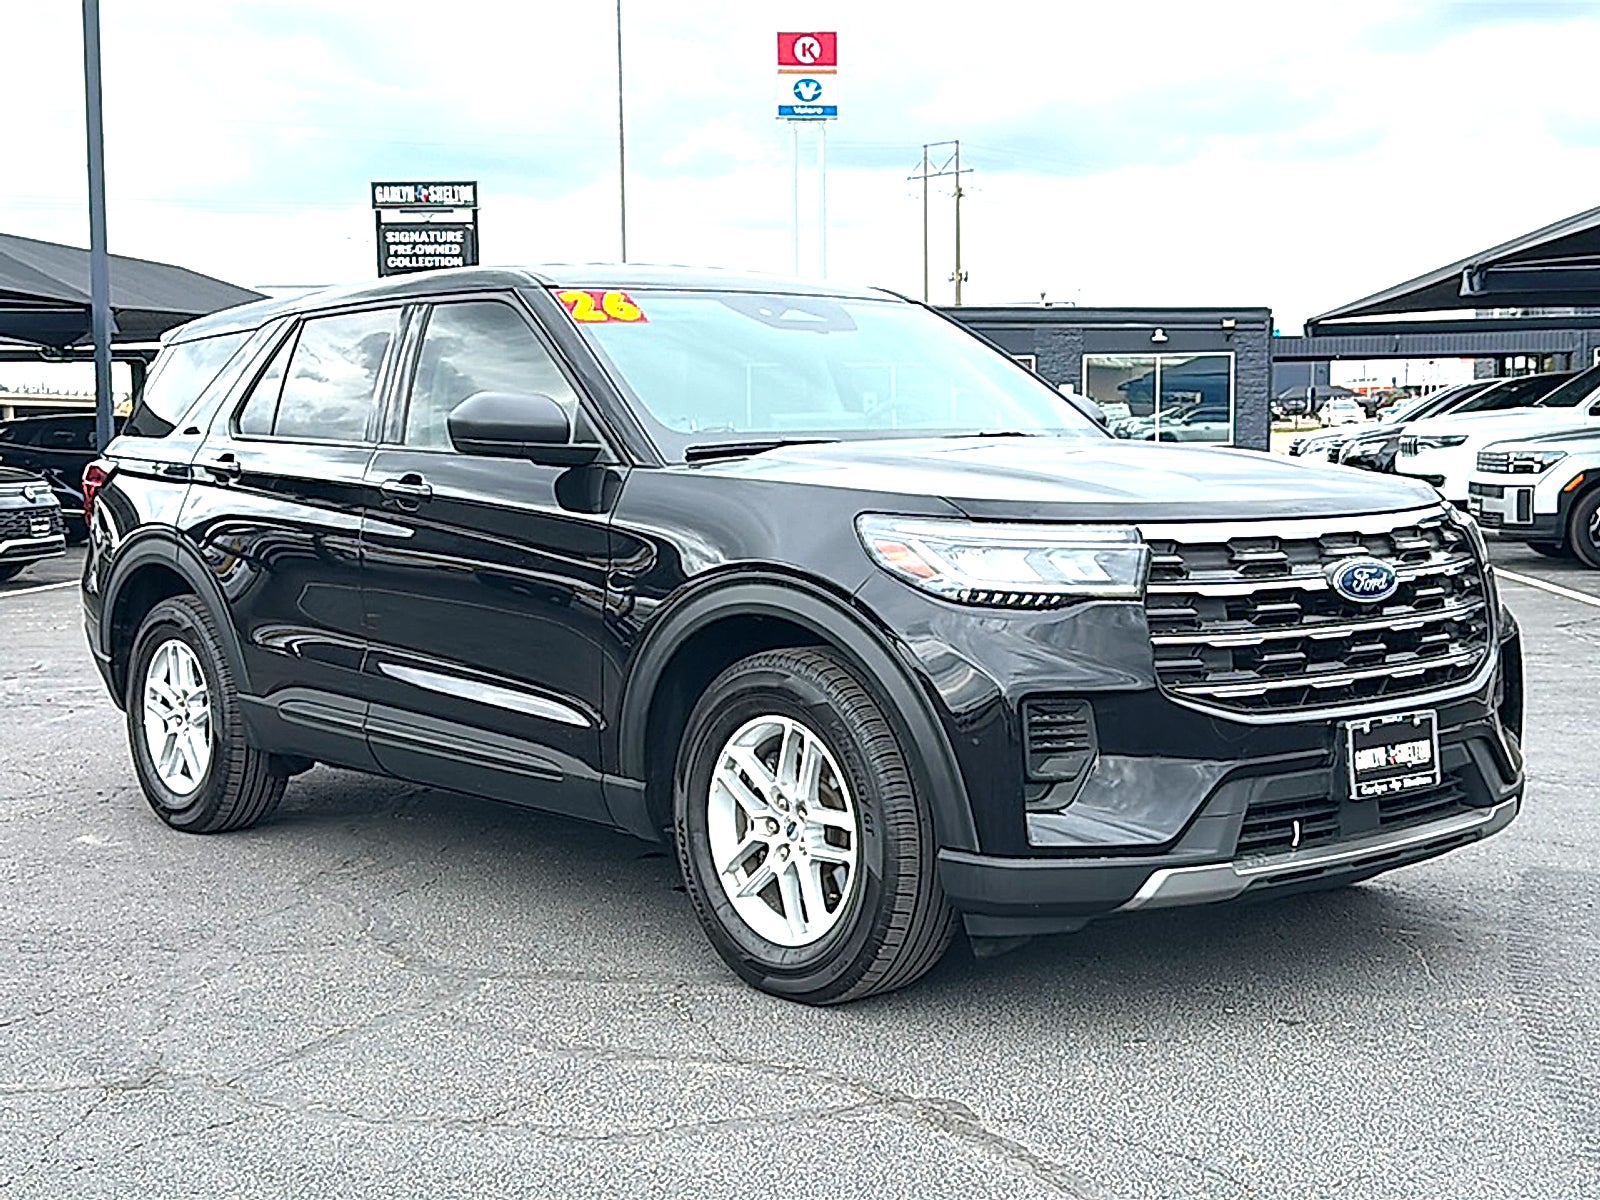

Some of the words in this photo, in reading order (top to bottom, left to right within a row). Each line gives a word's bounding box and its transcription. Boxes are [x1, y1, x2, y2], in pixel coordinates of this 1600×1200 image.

[802, 42, 817, 61] K
[385, 231, 464, 242] SIGNATURE
[389, 244, 460, 255] PRE-OWNED
[387, 256, 463, 267] COLLECTION
[558, 289, 642, 321] 26
[1352, 568, 1388, 592] Ford
